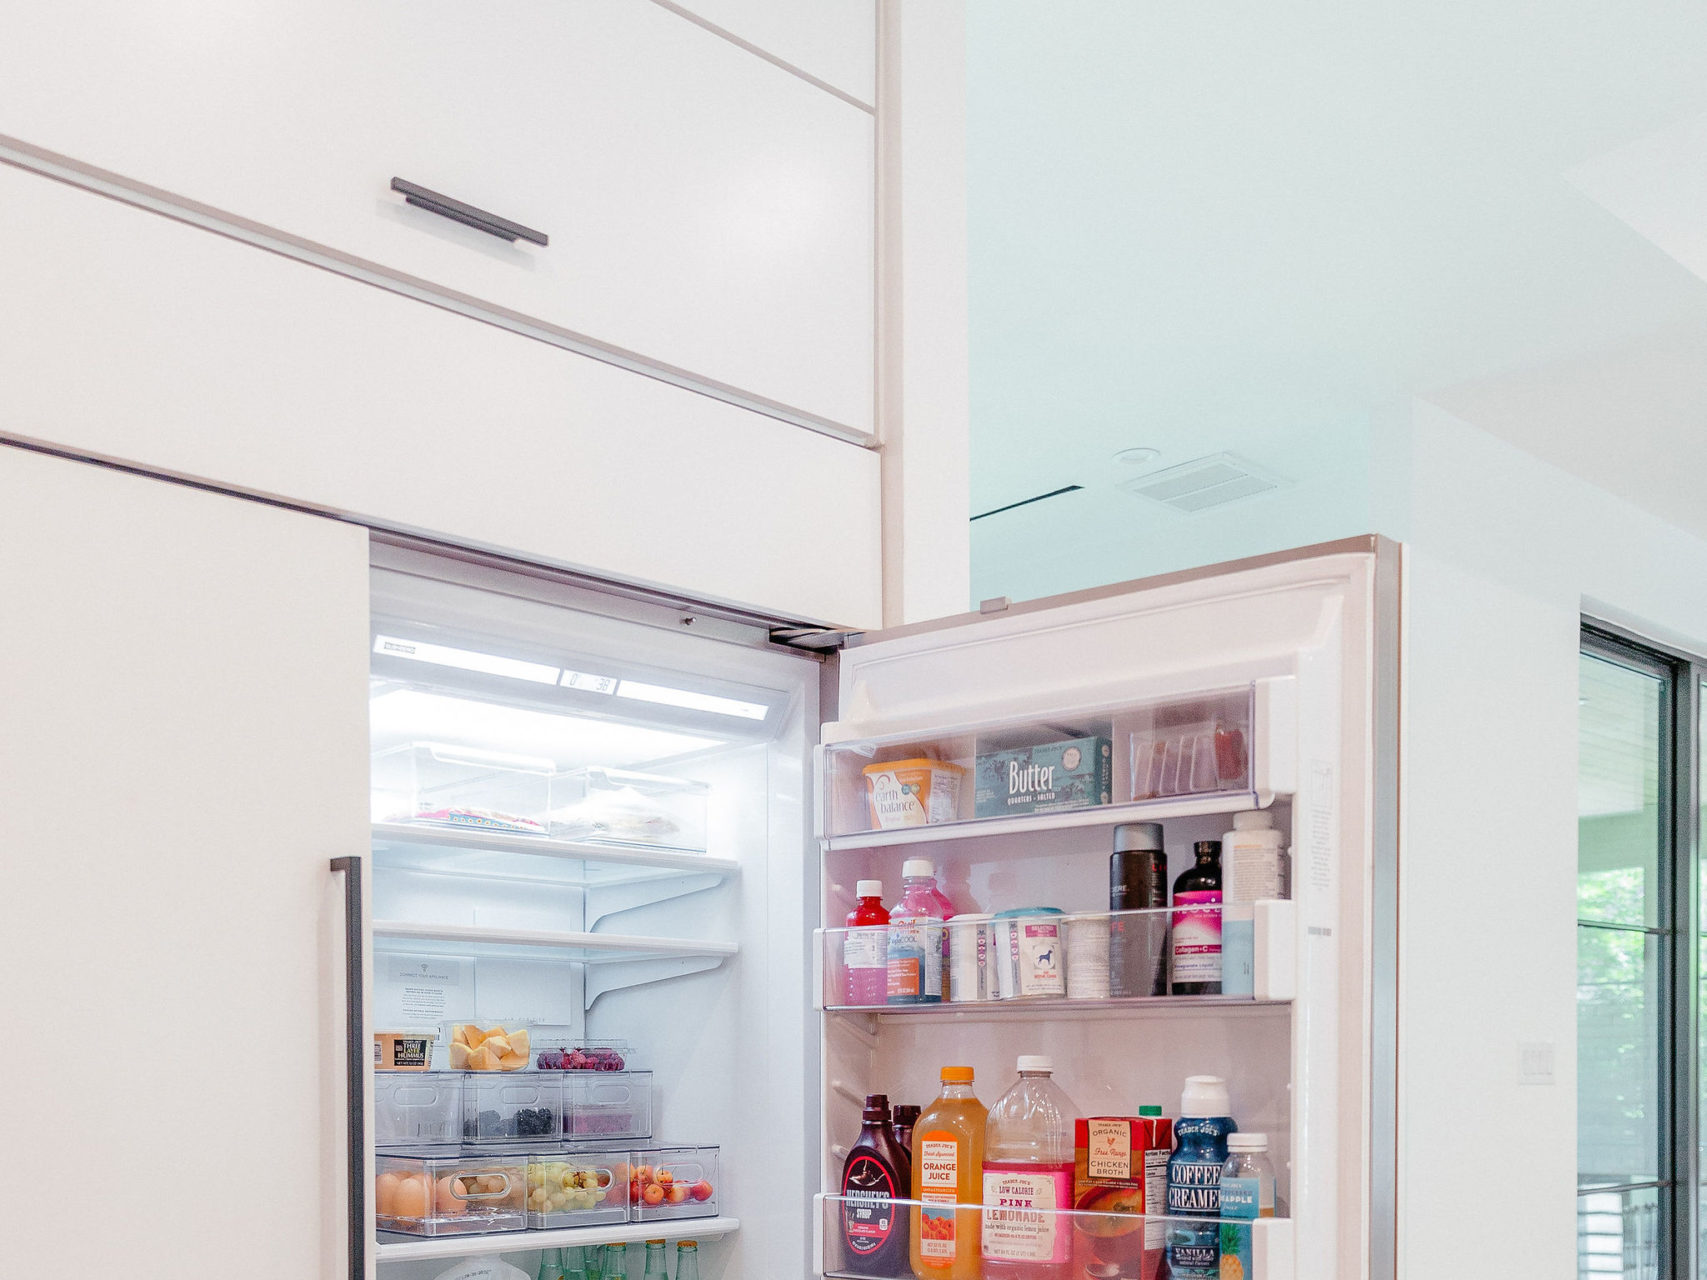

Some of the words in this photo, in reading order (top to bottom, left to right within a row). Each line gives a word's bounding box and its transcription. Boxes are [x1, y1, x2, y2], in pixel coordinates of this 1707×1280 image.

[1008, 760, 1056, 795] Butter
[875, 789, 899, 803] earth
[880, 800, 915, 815] balance
[1092, 1129, 1127, 1137] ORGANIC
[1178, 1125, 1199, 1137] TRADER
[1199, 1124, 1218, 1137] JOE'S
[923, 1162, 957, 1171] ORANGE
[1090, 1160, 1129, 1168] CHICKEN
[1172, 1164, 1220, 1185] COFFEE
[999, 1186, 1010, 1194] LOW
[1011, 1186, 1034, 1195] CALORIE
[846, 1189, 891, 1209] HERSHEY'S
[1000, 1198, 1032, 1208] PINK
[1168, 1187, 1221, 1208] CREAME
[856, 1208, 872, 1219] SYRUP
[986, 1208, 1046, 1223] LEMONADE
[1175, 1248, 1215, 1257] VANILLA
